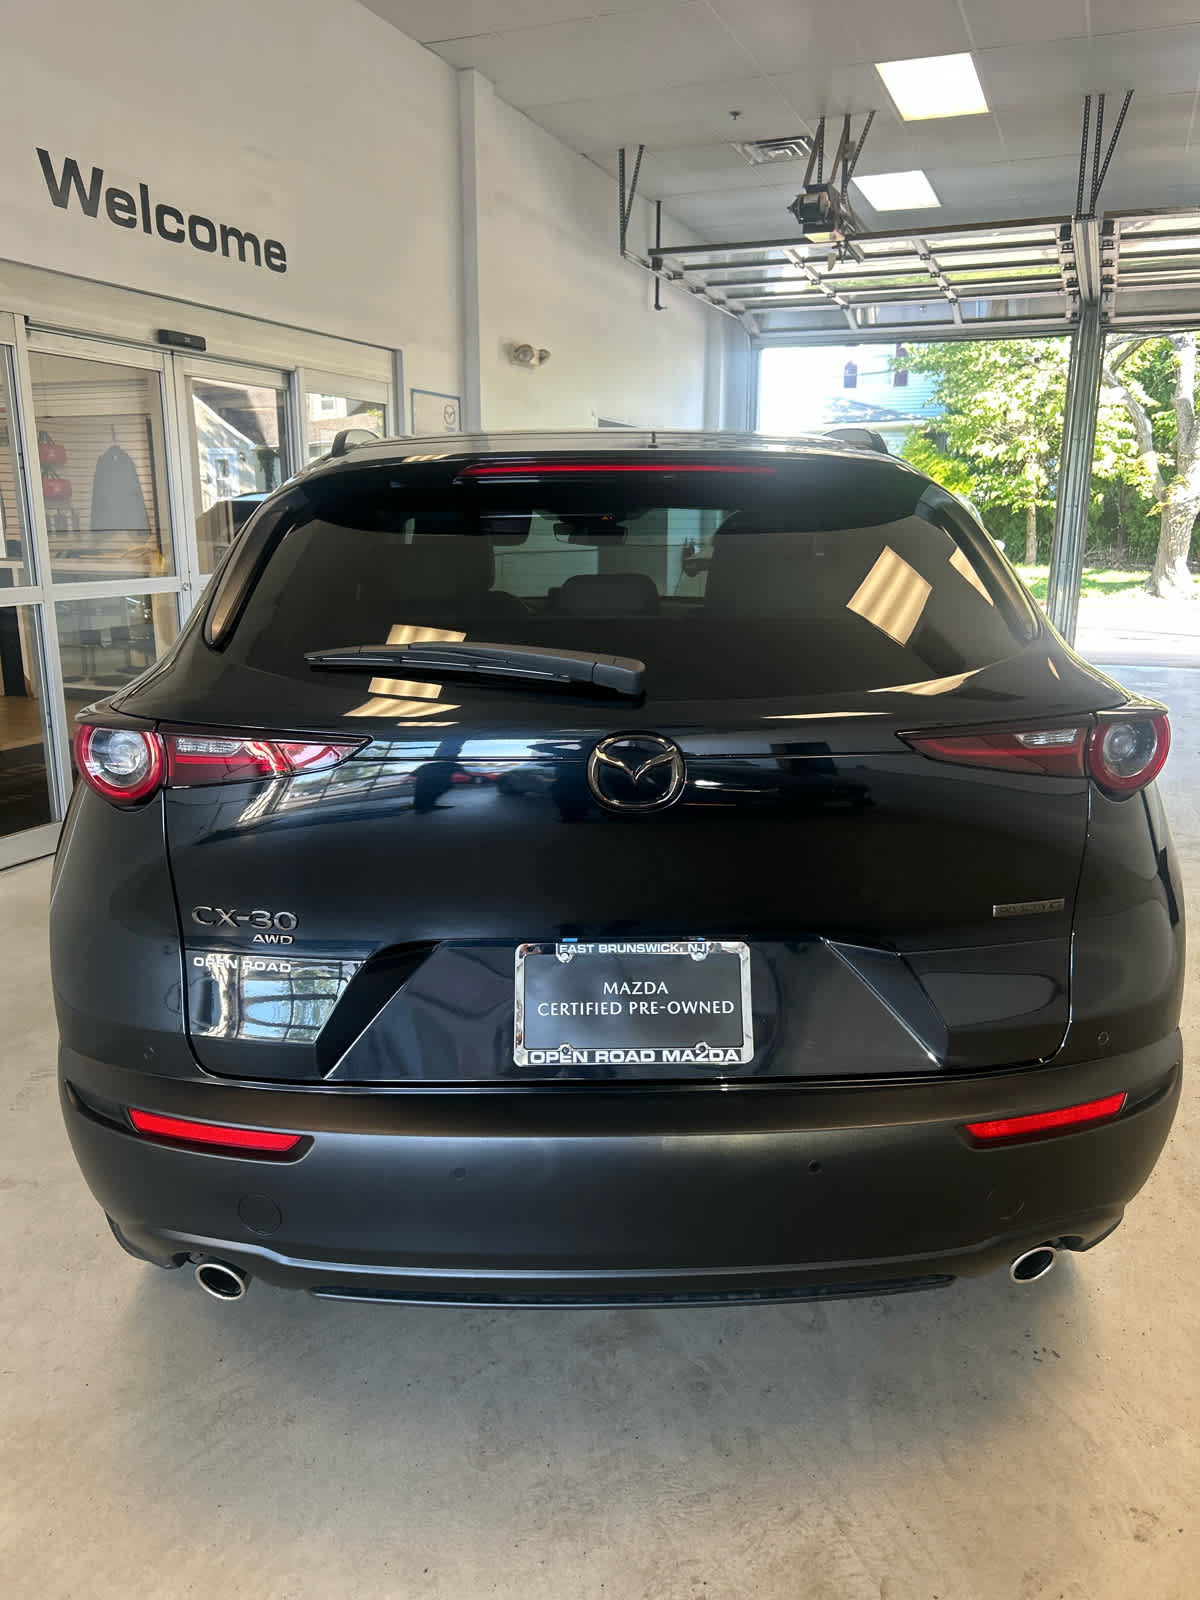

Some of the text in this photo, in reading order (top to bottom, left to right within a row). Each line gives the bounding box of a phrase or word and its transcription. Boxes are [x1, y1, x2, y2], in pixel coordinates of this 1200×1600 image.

[35, 146, 287, 273] Welcome
[191, 905, 298, 931] CX-30
[252, 934, 294, 945] AWD
[560, 944, 595, 953] EAST
[688, 943, 705, 953] NJ
[193, 956, 292, 973] OPEN ROAD
[603, 981, 669, 995] MAZDA
[537, 1000, 735, 1016] CERTIFIED PRE-OWNED
[530, 1049, 740, 1064] OPEN ROAD MAZDA
